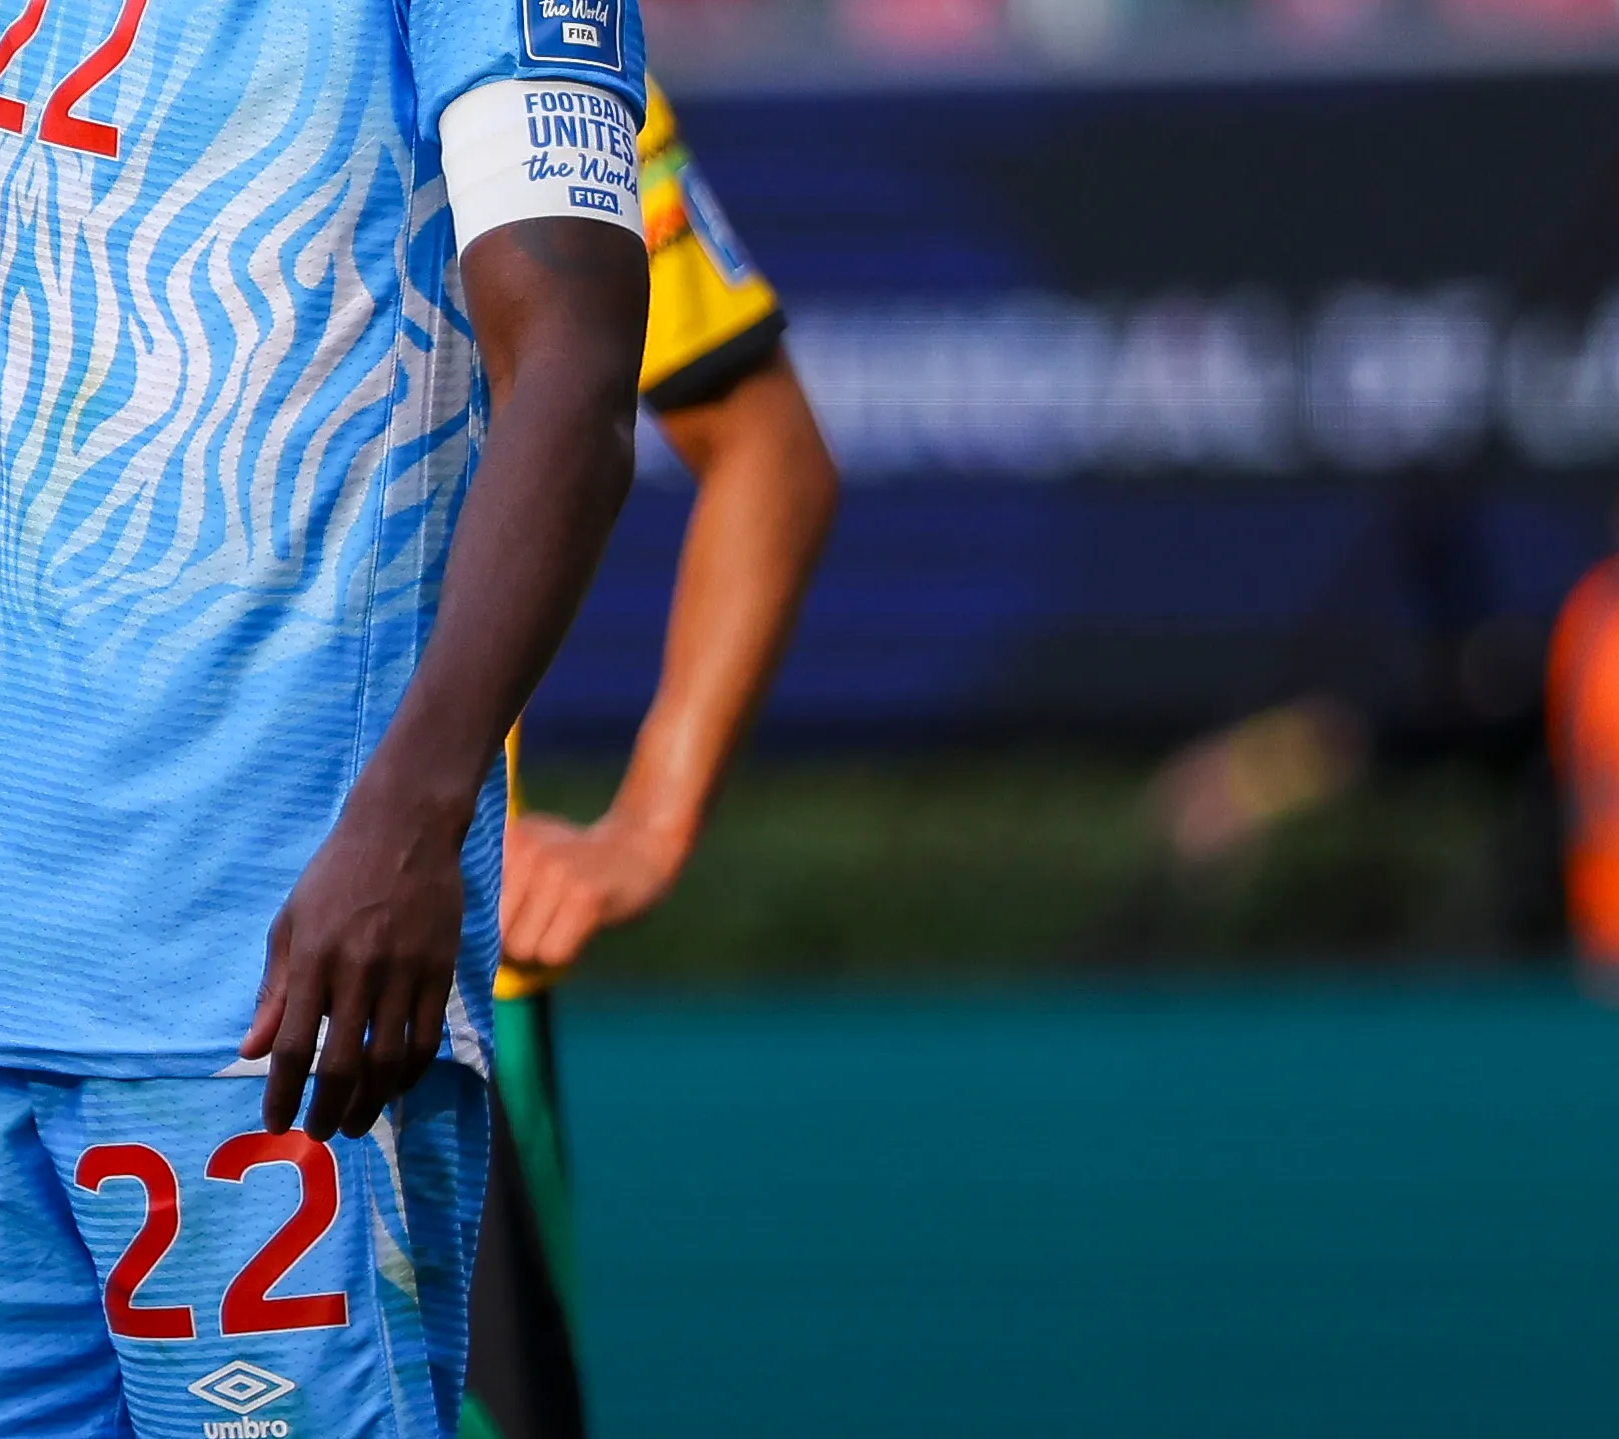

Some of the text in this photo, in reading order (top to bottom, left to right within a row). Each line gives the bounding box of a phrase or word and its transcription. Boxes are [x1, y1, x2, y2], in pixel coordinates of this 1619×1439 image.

[567, 26, 595, 43] FIFA
[523, 92, 632, 134] FOOTBALL
[527, 116, 634, 168] UNITES
[522, 151, 639, 204] the World
[573, 190, 615, 210] FIFA
[73, 1127, 350, 1341] 22
[203, 1416, 289, 1439] umbro
